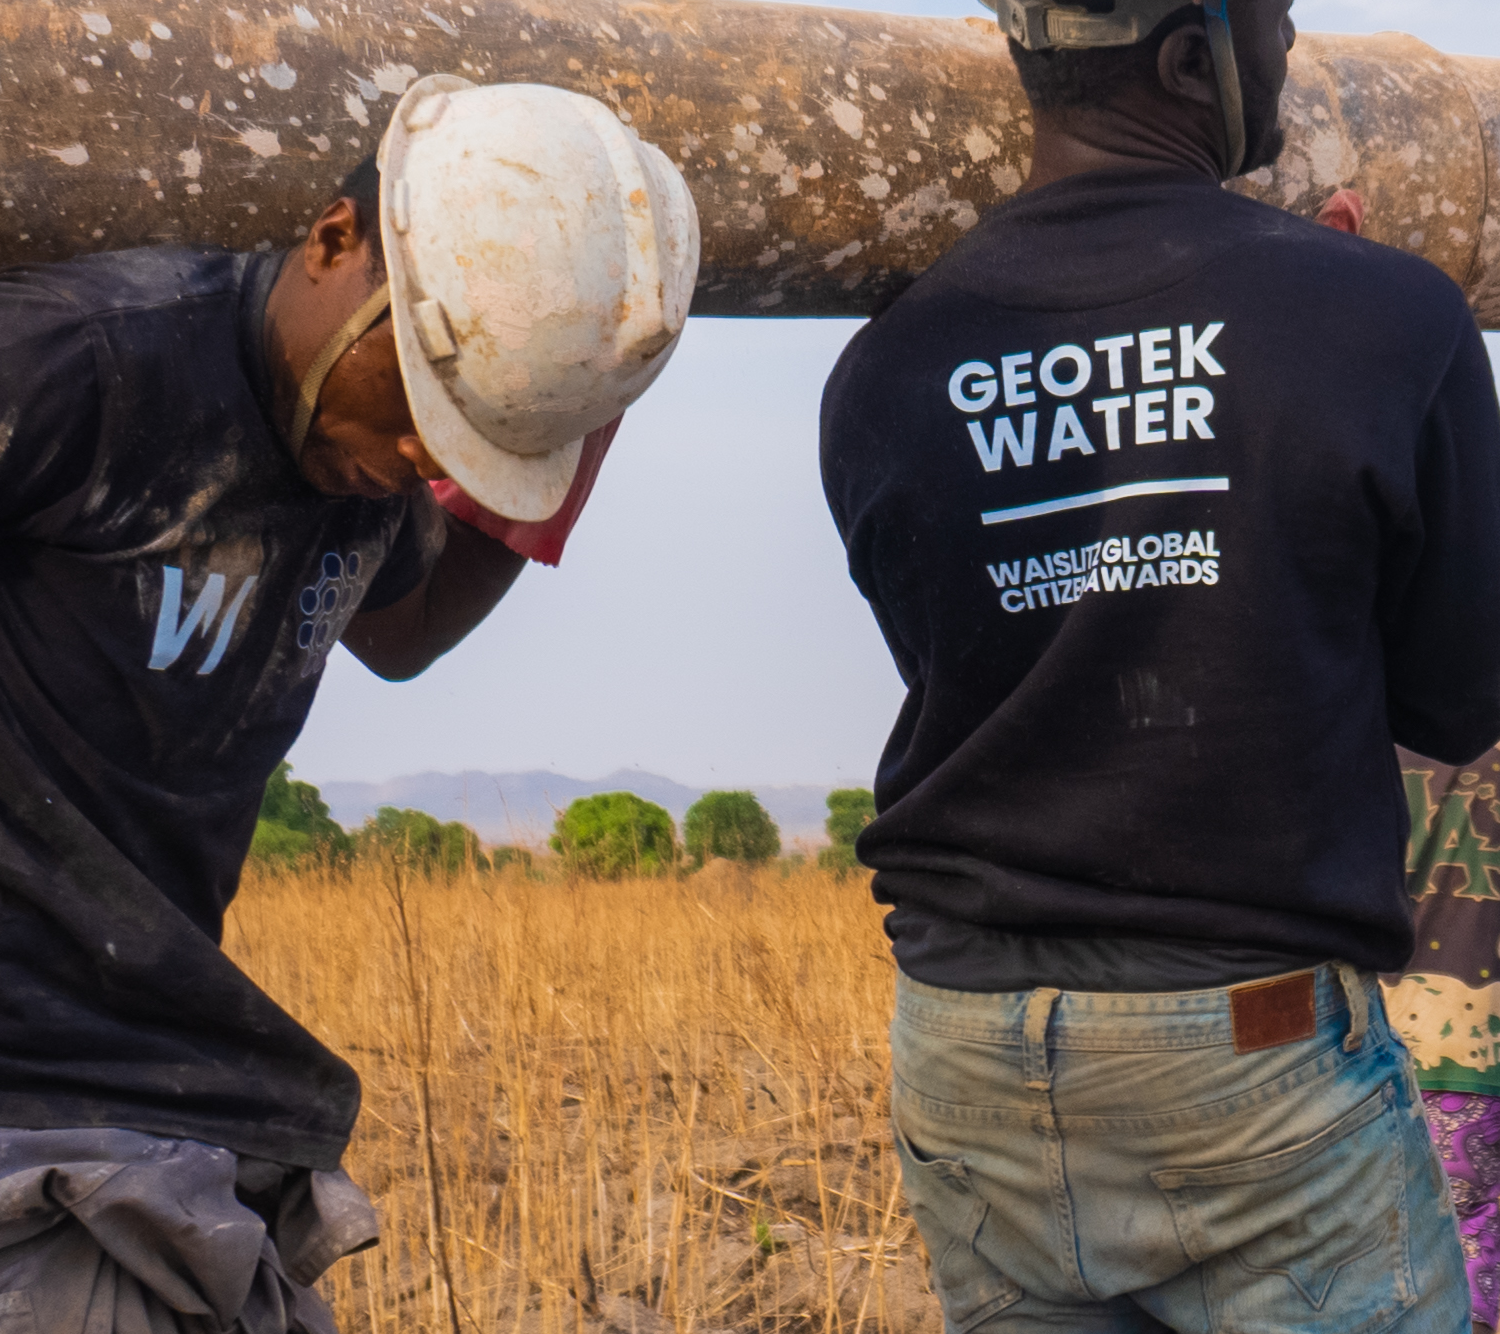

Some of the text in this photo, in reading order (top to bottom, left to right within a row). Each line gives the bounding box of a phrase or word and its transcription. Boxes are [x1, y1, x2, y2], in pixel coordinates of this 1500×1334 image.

[948, 321, 1226, 413] GEOTEK
[966, 387, 1216, 473] WATER
[986, 531, 1221, 589] WAISLITZ GLOBAL
[1083, 558, 1220, 593] AWARDS
